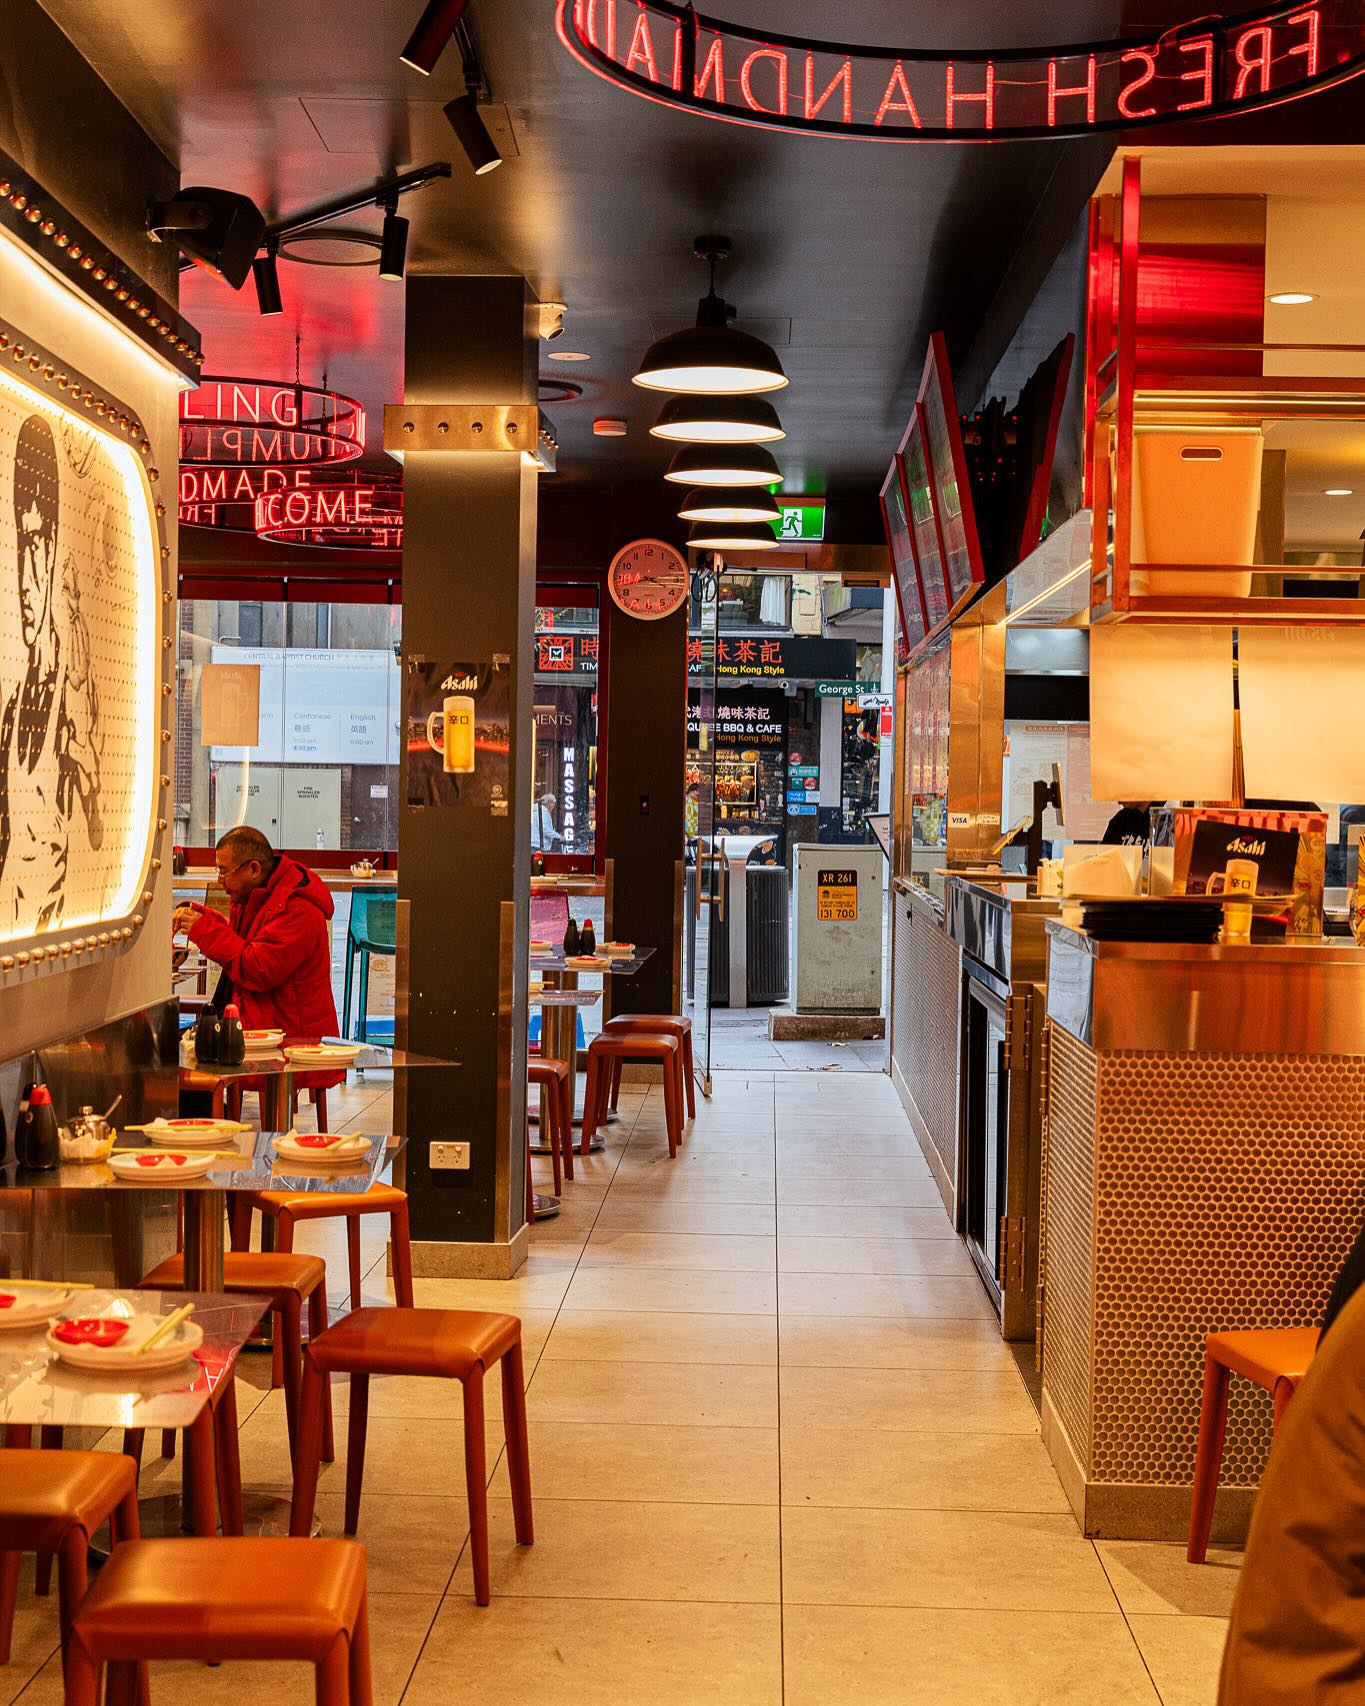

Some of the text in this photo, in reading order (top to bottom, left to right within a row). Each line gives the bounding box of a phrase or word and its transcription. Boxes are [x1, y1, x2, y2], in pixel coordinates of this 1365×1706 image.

[644, 549, 654, 557] 12
[623, 562, 632, 570] 10
[668, 562, 676, 570] 2
[622, 589, 630, 597] 8
[659, 598, 666, 607] 5
[305, 653, 334, 661] CHURCH
[740, 665, 762, 675] Kong
[763, 665, 785, 675] Style
[441, 675, 478, 691] Asahi
[818, 684, 865, 696] George St
[293, 712, 332, 720] Cantonese
[350, 713, 376, 721] English
[449, 715, 469, 725] 辛口
[723, 723, 744, 732] BBQ
[746, 724, 754, 733] &
[756, 724, 782, 733] CAFE
[738, 734, 759, 743] Kong
[761, 735, 782, 744] Style
[563, 747, 575, 854] MASSAGE
[1226, 837, 1266, 857] Asahi
[822, 873, 852, 883] XR 261
[1230, 878, 1251, 889] 辛口
[820, 909, 855, 918] 131 700
